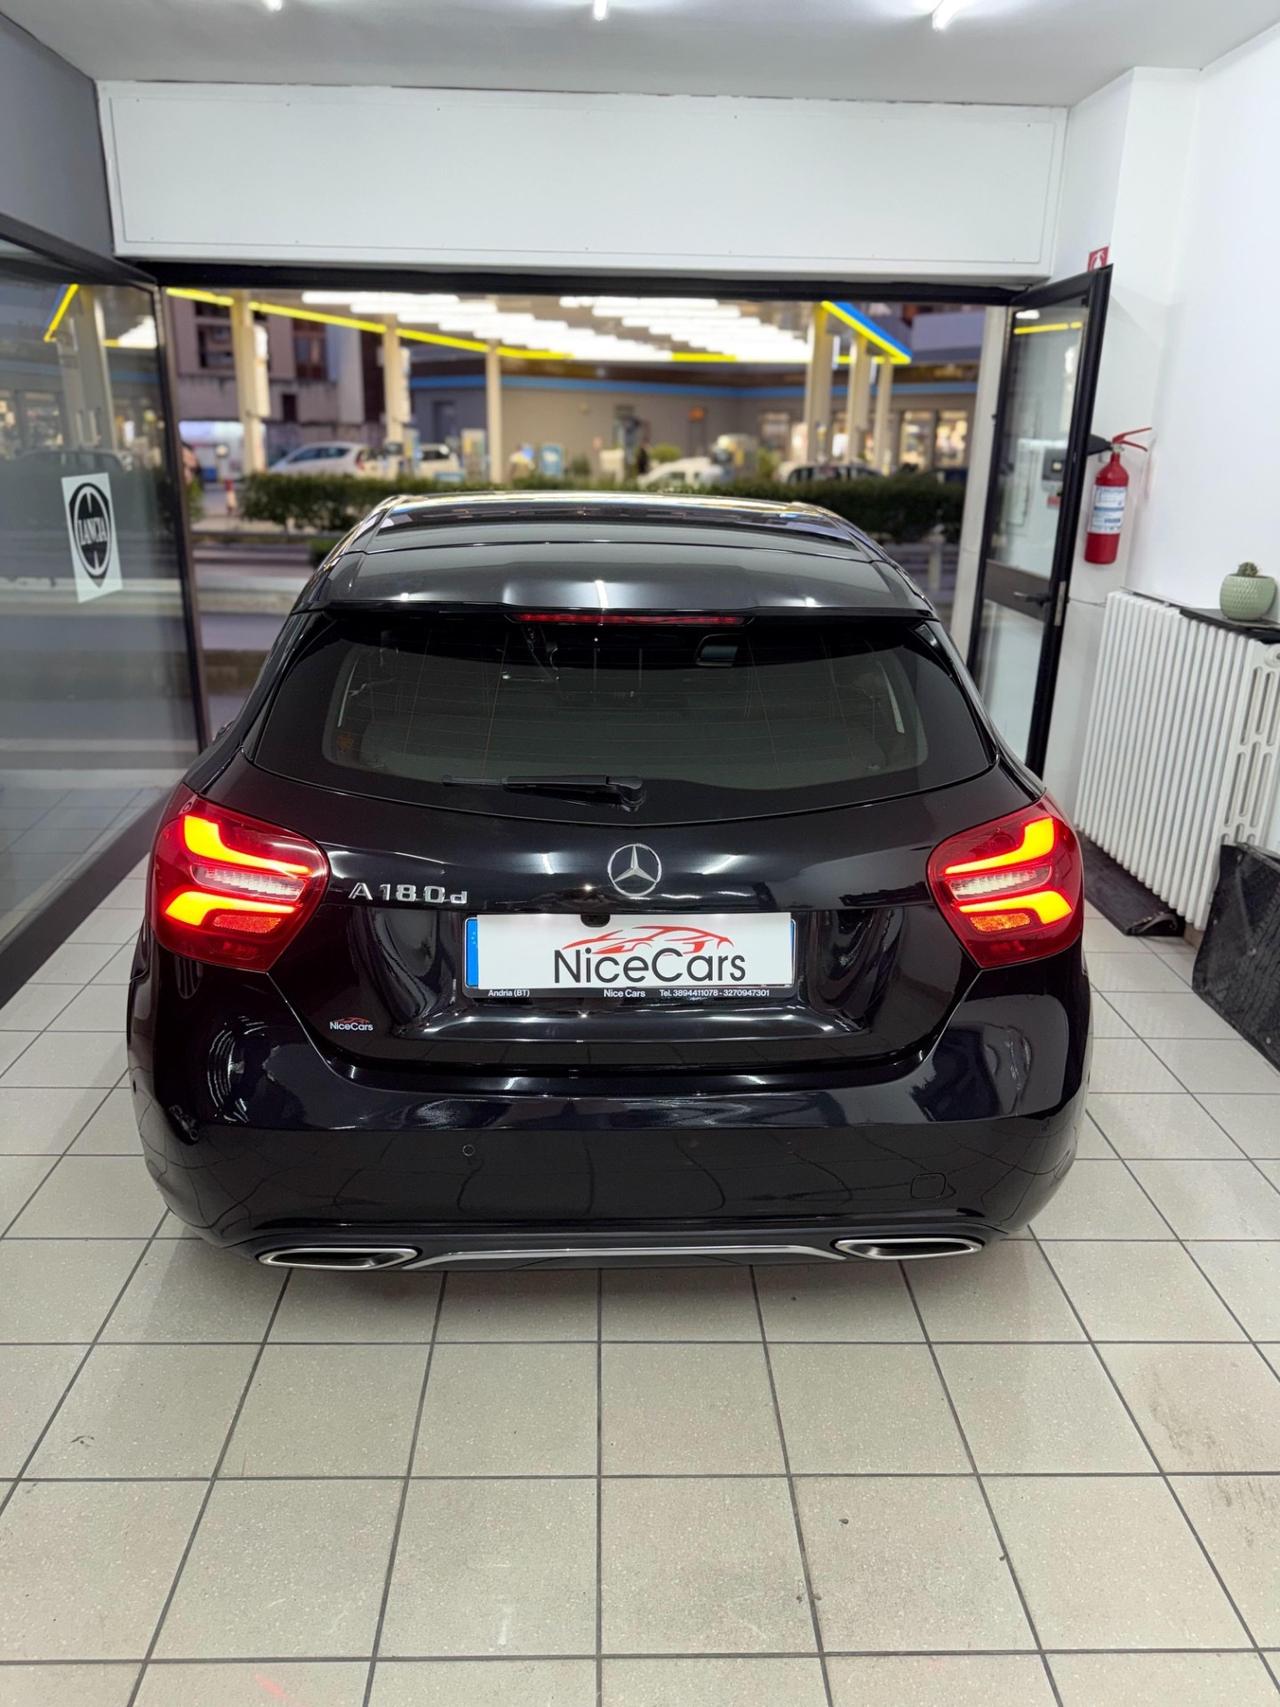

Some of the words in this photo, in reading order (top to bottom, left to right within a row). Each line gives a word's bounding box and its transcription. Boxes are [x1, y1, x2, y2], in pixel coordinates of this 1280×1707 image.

[554, 947, 746, 984] NiceCars
[488, 989, 513, 997] Andria
[514, 989, 530, 998] (BT)
[603, 989, 624, 998] Nice
[625, 989, 646, 998] Cars
[673, 989, 718, 997] 3894411078
[723, 989, 770, 997] 3270947301
[329, 1021, 374, 1031] NiceCars
